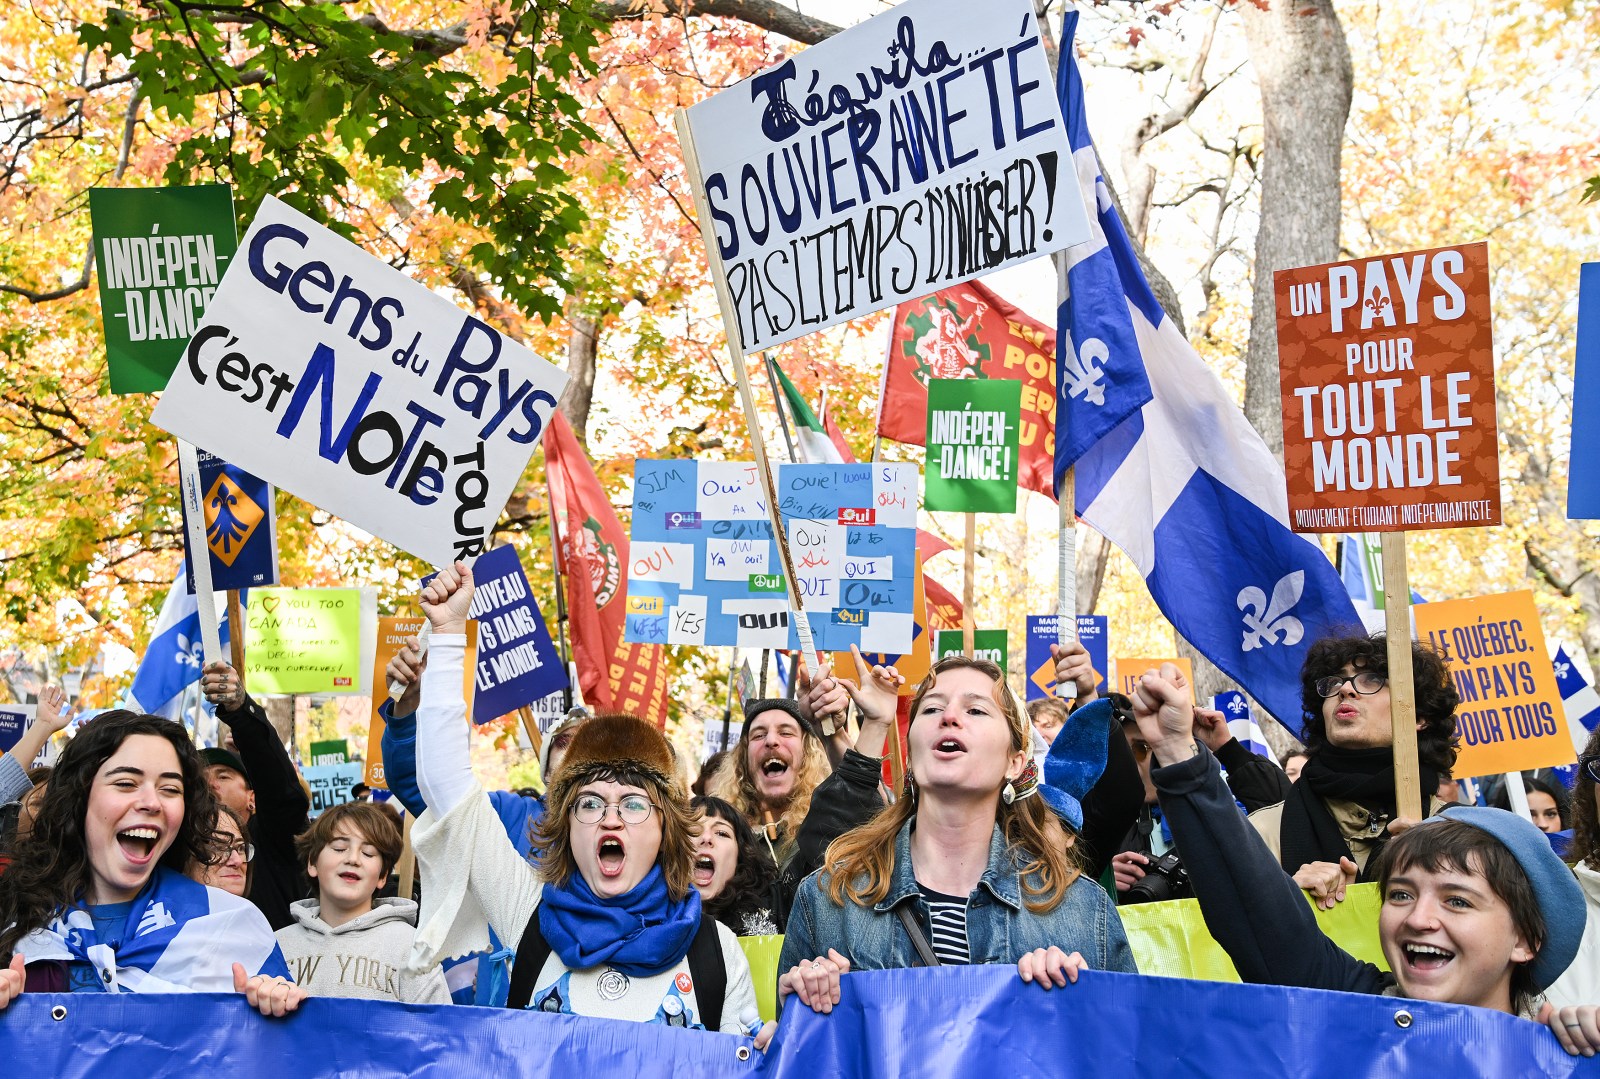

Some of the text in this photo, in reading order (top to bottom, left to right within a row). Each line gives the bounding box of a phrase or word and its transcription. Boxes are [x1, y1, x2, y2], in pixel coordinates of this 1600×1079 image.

[102, 223, 228, 289] INDÉPEN-
[726, 249, 796, 349] PAS
[1289, 250, 1466, 333] UN PAYS
[248, 223, 558, 444] Gens du Pays
[187, 324, 295, 413] C'est
[1345, 337, 1415, 375] POUR
[931, 402, 1013, 446] INDÉPEN-
[1294, 371, 1473, 438] TOUT LE
[637, 468, 686, 494] SIM
[932, 445, 1011, 481] -DANCE!
[1311, 430, 1462, 493] MONDE
[452, 440, 490, 566] TOUR
[702, 479, 742, 497] Oui
[1295, 499, 1492, 528] MOUVEMENT ÉTUDIANT INDÉPENDANTISTE
[634, 546, 674, 576] OUI
[710, 552, 726, 567] YA
[318, 599, 344, 609] TOO
[674, 610, 705, 635] YES
[738, 611, 789, 630] OUI
[493, 605, 537, 645] DANS
[490, 640, 543, 684] MONDE
[1475, 661, 1536, 701] PAYS
[1501, 701, 1557, 740] TOUS
[336, 954, 401, 1001] YORK
